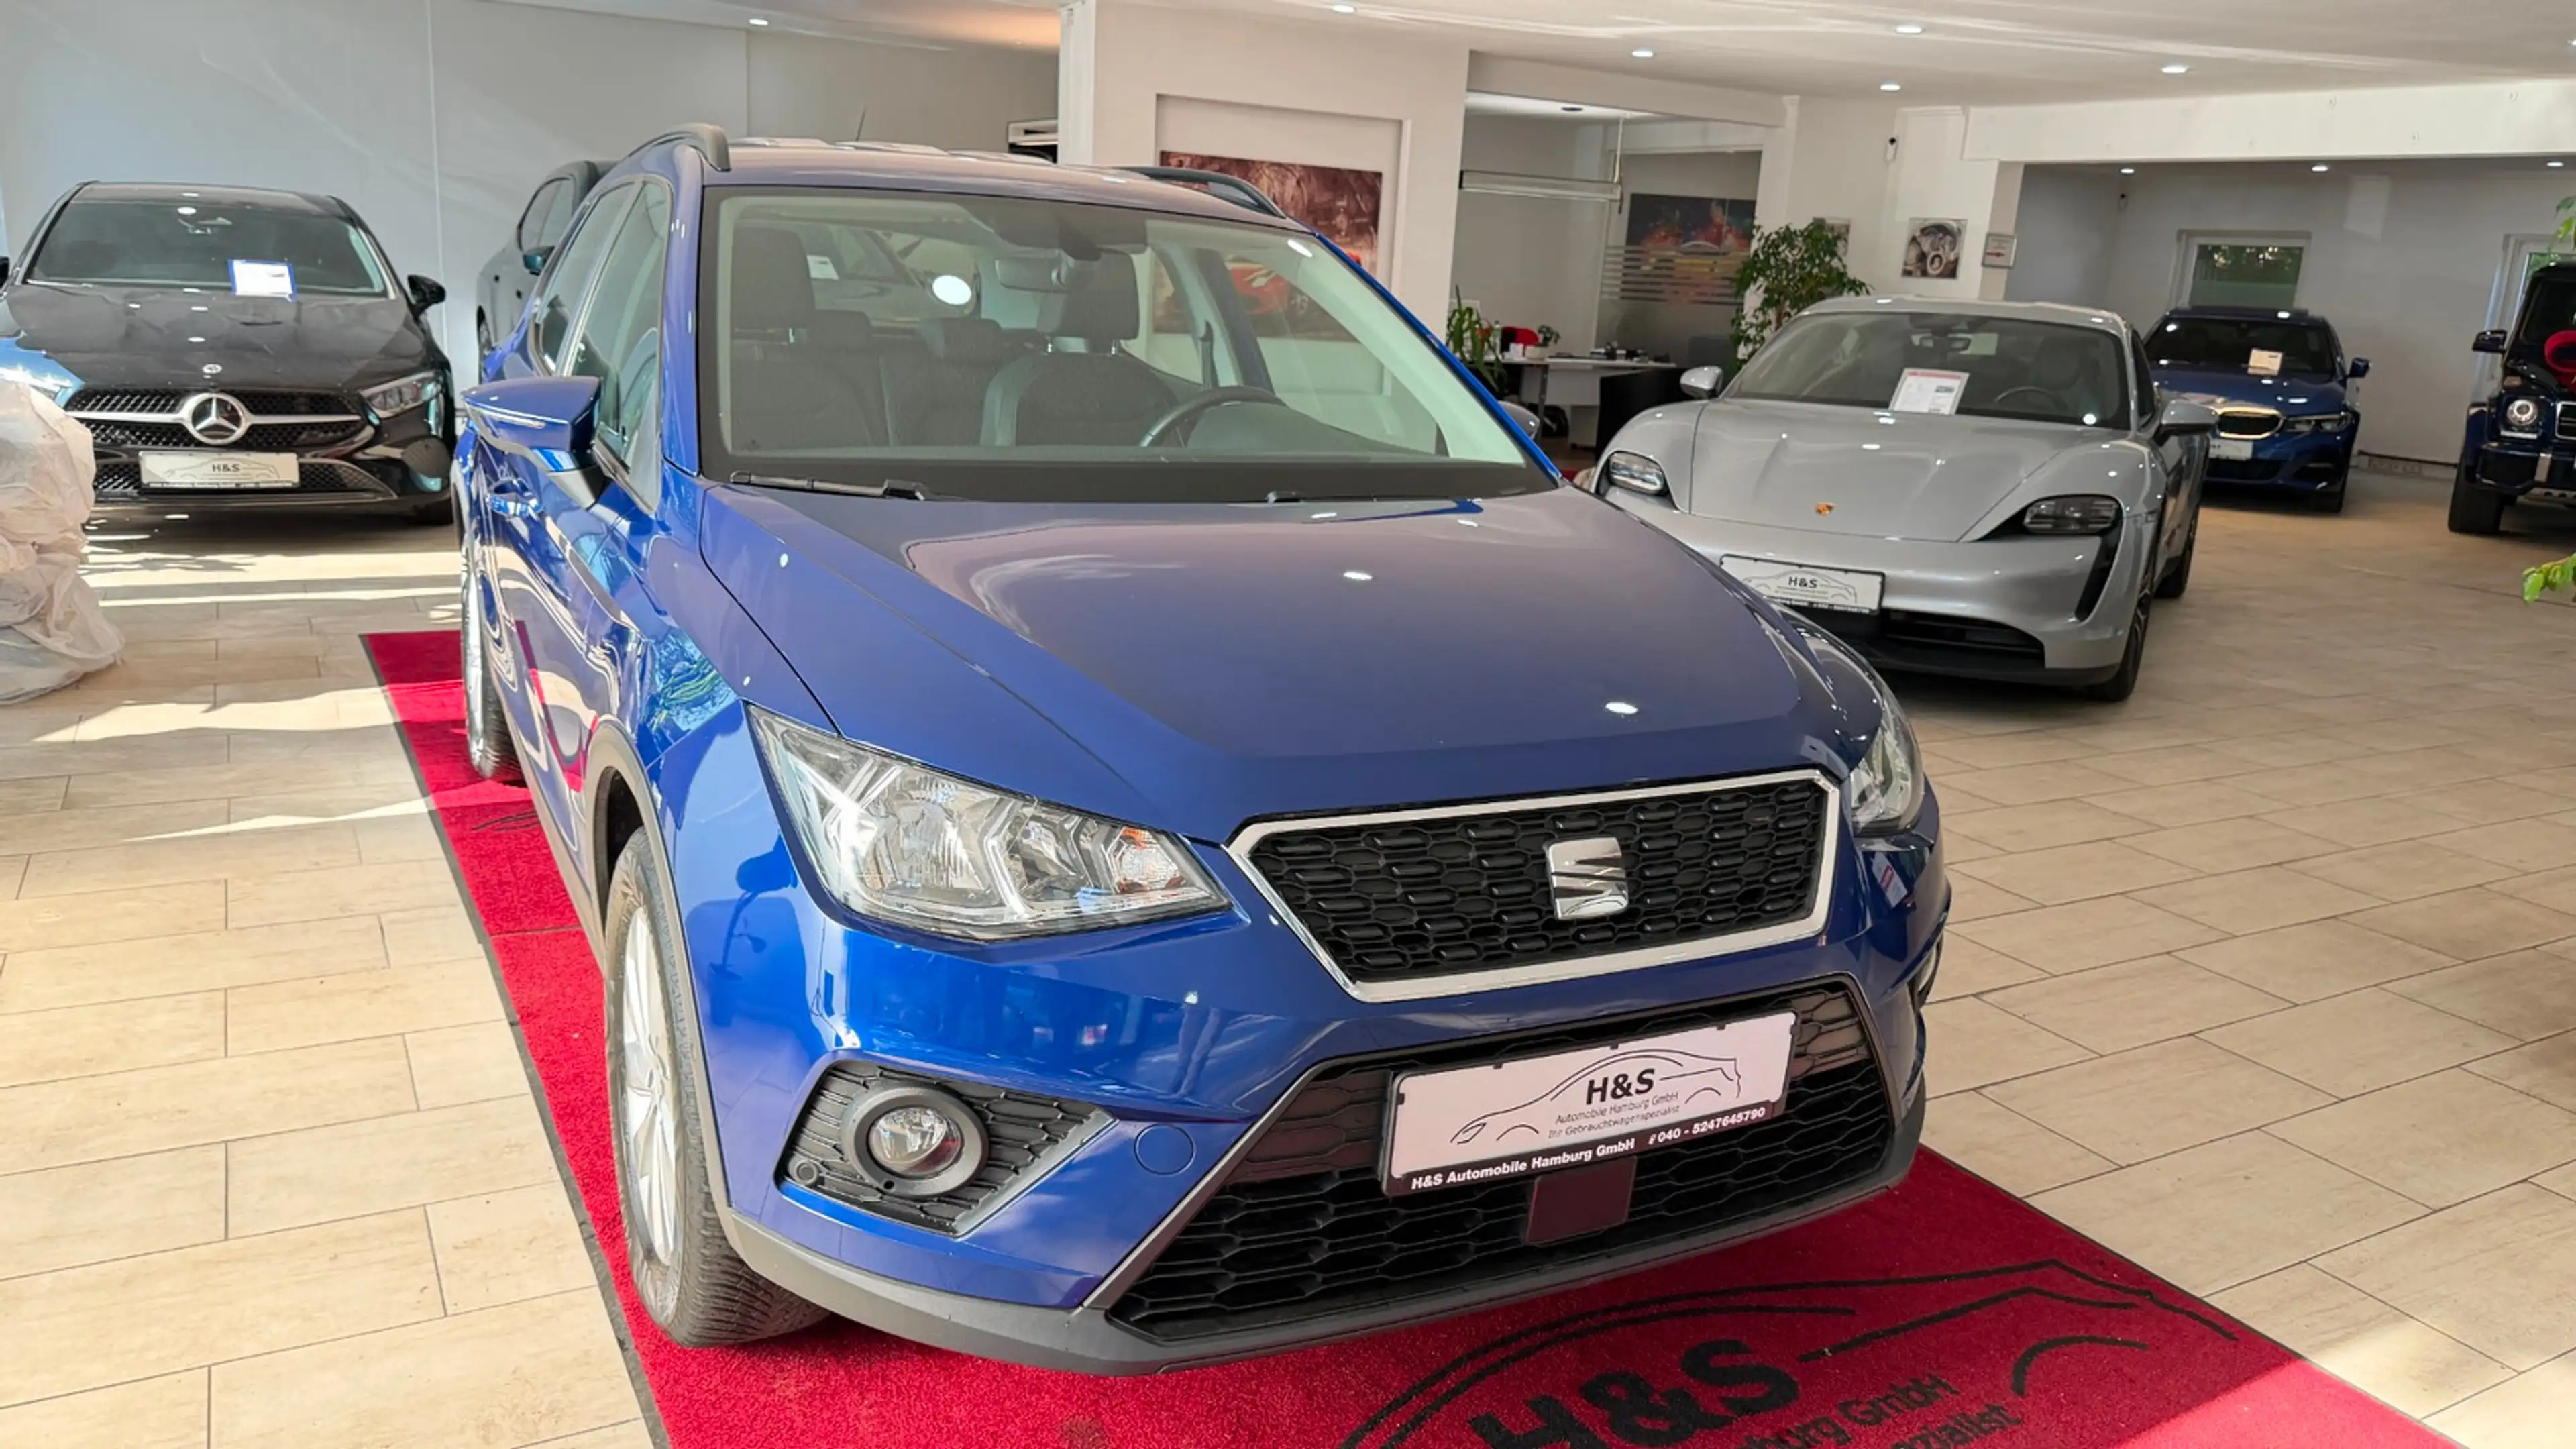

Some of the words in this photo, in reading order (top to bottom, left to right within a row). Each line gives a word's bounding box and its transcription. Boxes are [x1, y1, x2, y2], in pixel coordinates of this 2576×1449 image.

[212, 463, 240, 472] H&S
[1788, 576, 1817, 589] H&S
[1586, 1068, 1655, 1105] H&S
[1555, 1107, 1607, 1124] Automobile
[1610, 1099, 1650, 1114] Hamburg
[1652, 1091, 1679, 1106] GmbH
[1411, 1172, 1443, 1189] H&S
[1446, 1161, 1527, 1184] Automobile
[1532, 1149, 1592, 1170] Hamburg
[1596, 1138, 1635, 1157] GmbH
[1658, 1128, 1682, 1142] 040
[1692, 1107, 1766, 1134] 5247645790
[1837, 1371, 1963, 1426] GmbH
